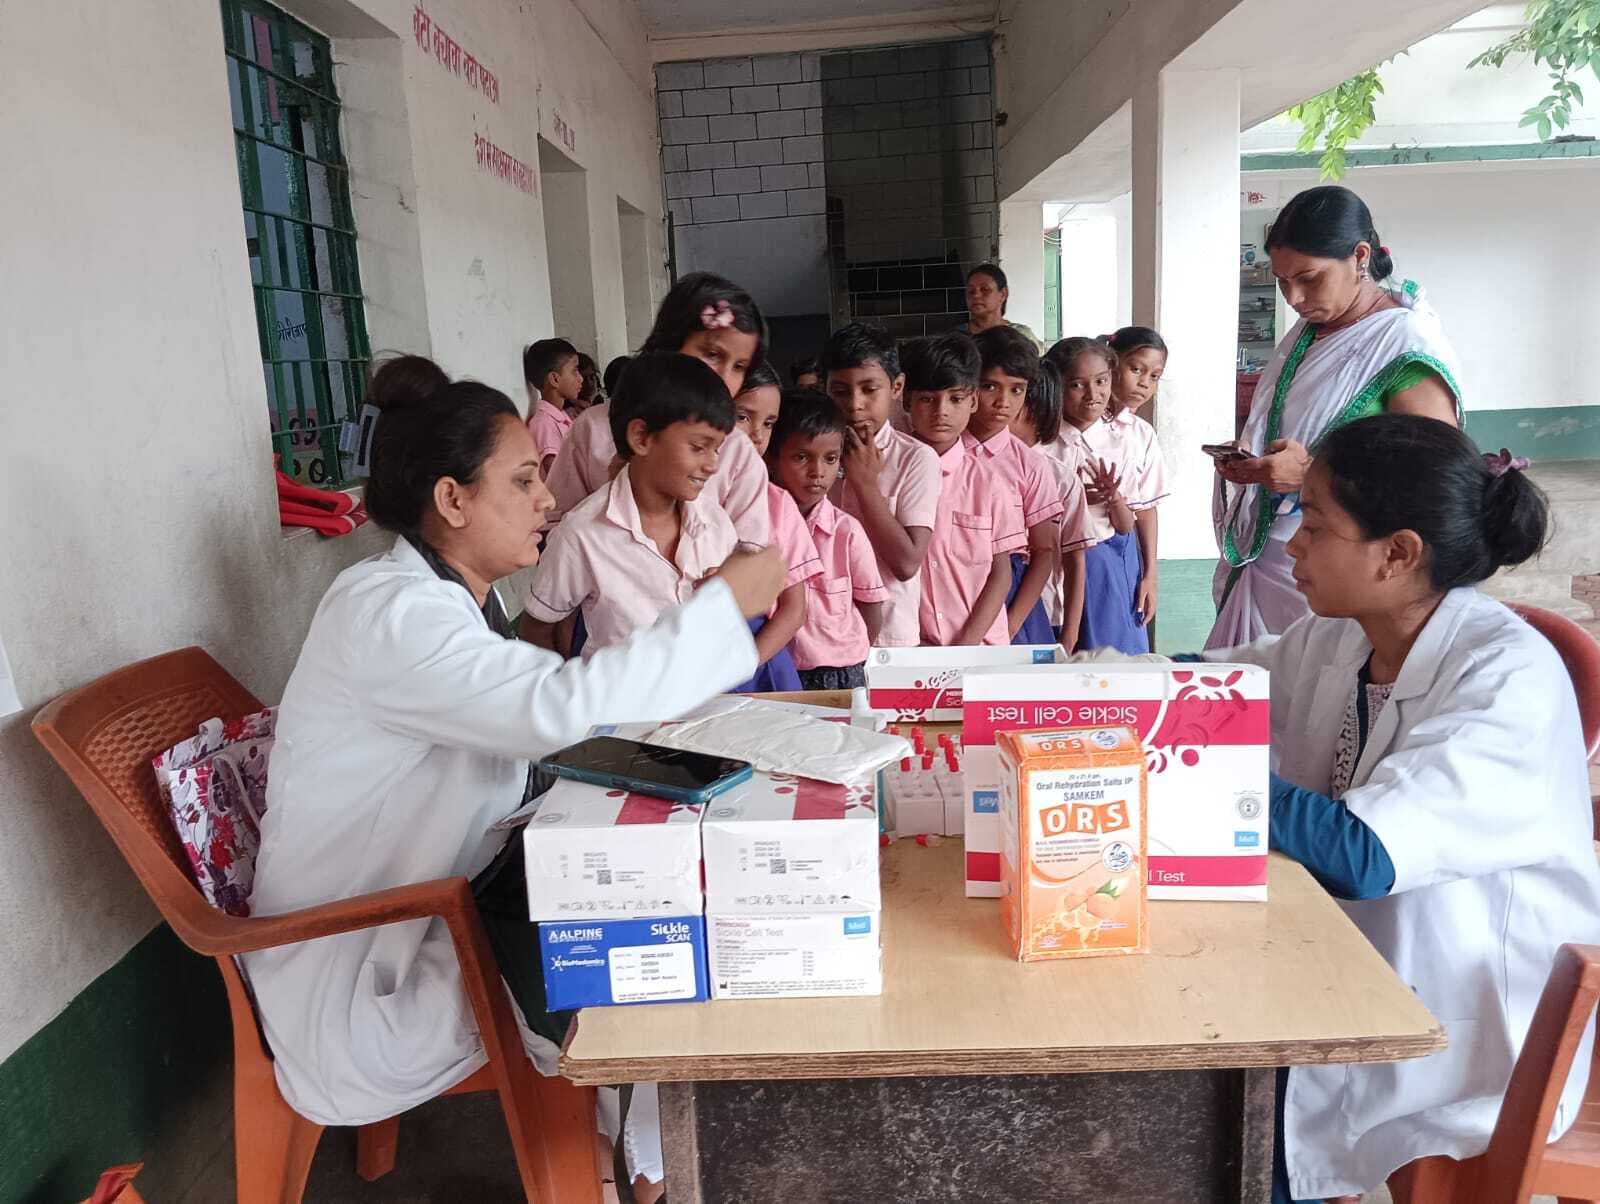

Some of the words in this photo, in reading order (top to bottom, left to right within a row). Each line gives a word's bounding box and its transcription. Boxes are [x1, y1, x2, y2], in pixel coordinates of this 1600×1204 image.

[987, 706, 1029, 724] Test
[1034, 706, 1073, 725] Cell
[1078, 706, 1137, 725] Sickle
[1036, 782, 1053, 791] Oral
[1054, 780, 1101, 790] Rehydration
[1063, 790, 1105, 801] SAMKEM
[1046, 803, 1123, 833] ORS
[1156, 870, 1185, 882] Test
[560, 928, 603, 940] ALPINE
[651, 922, 689, 935] Sickle
[665, 933, 692, 943] SCAN
